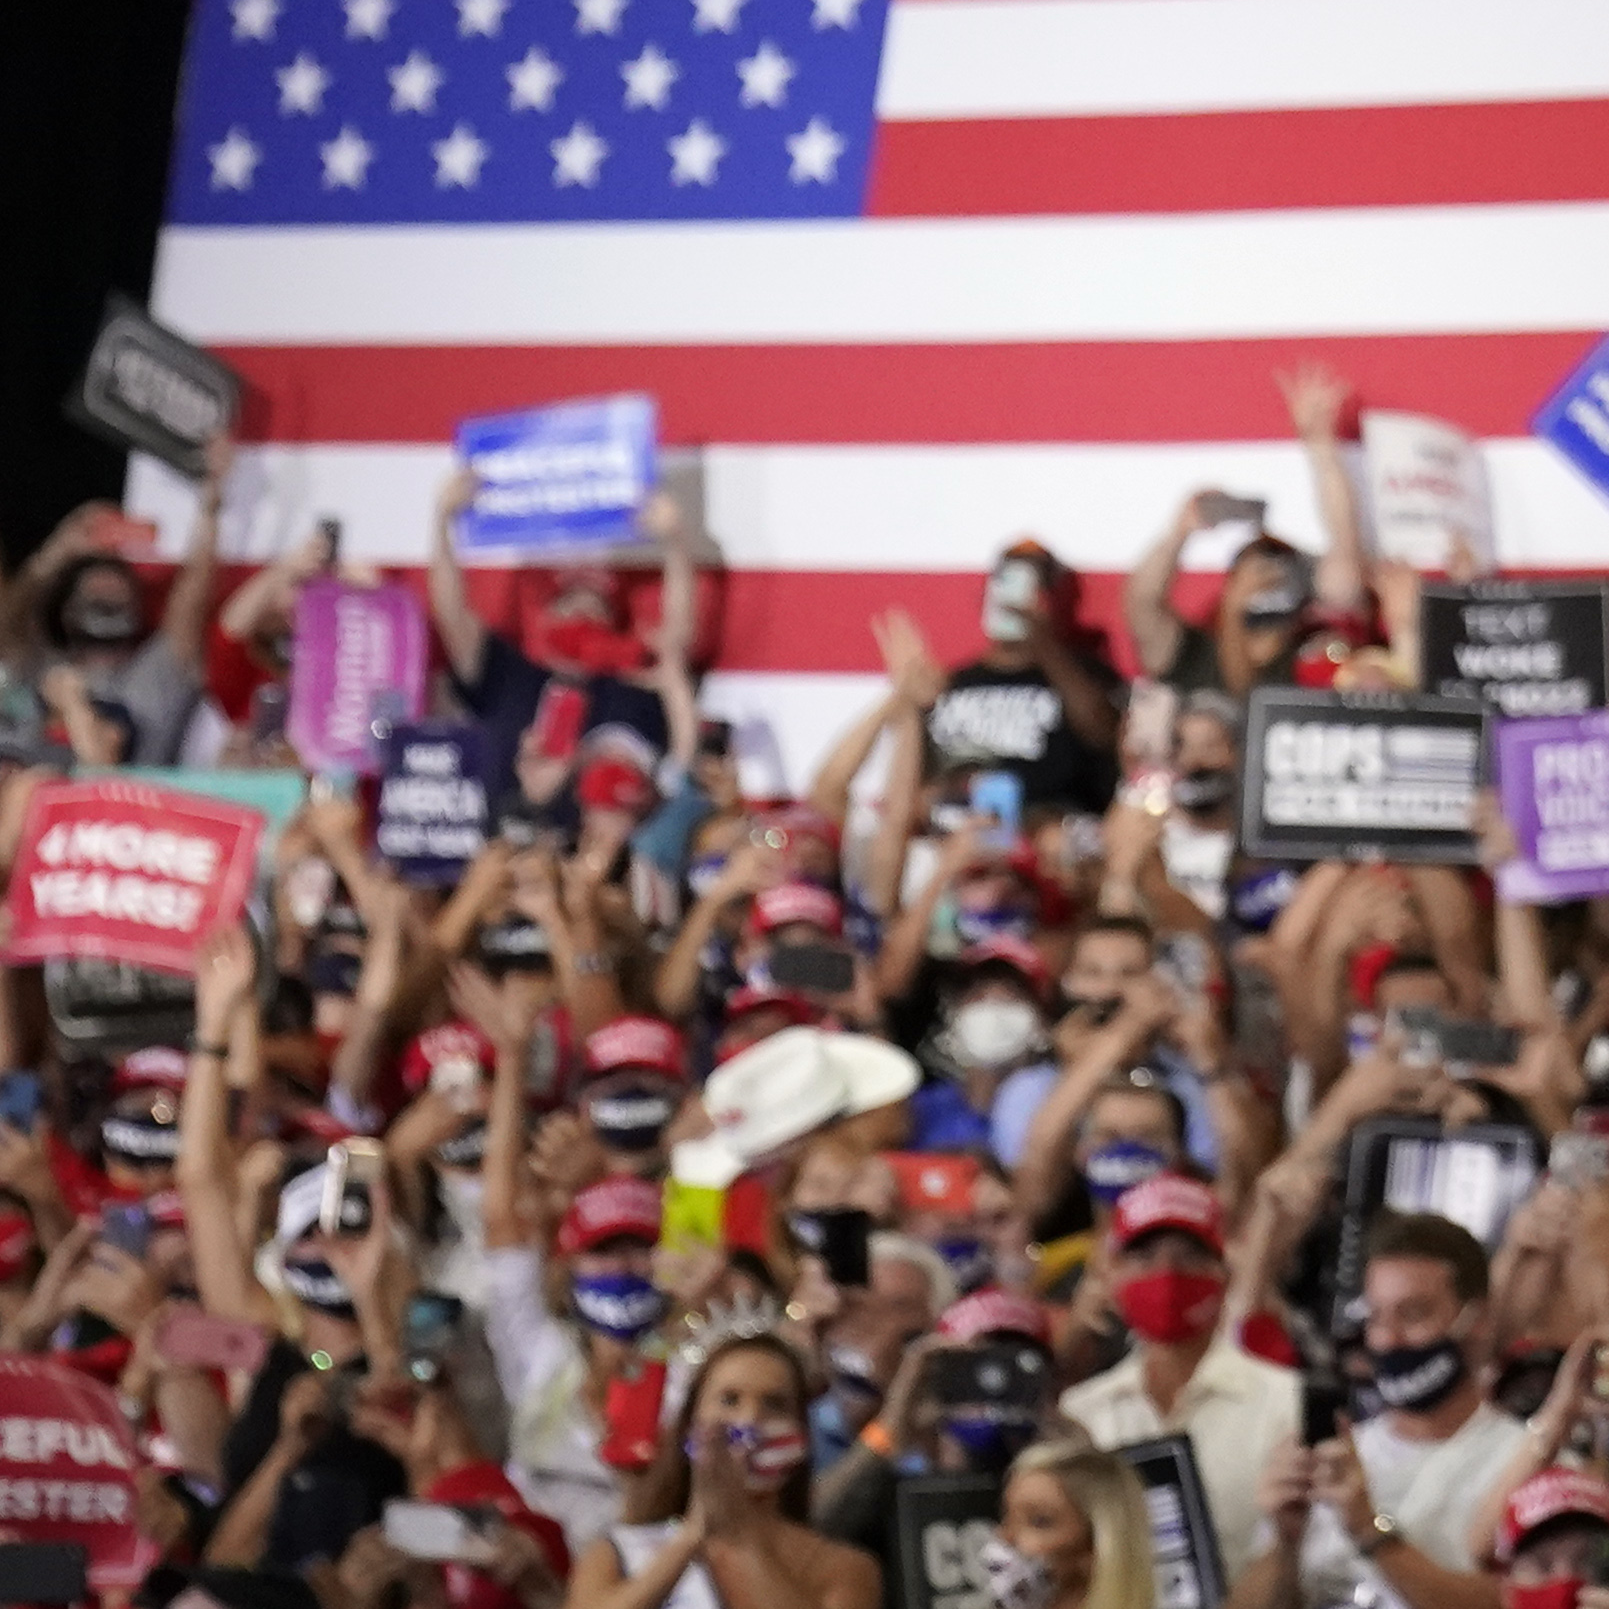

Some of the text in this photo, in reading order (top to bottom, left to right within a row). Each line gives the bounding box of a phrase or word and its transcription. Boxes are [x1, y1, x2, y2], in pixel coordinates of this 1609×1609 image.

[1265, 723, 1385, 781] COPS
[38, 822, 220, 883] 4 MORE
[31, 872, 202, 932] YEARS!
[0, 1415, 131, 1467] EFUL
